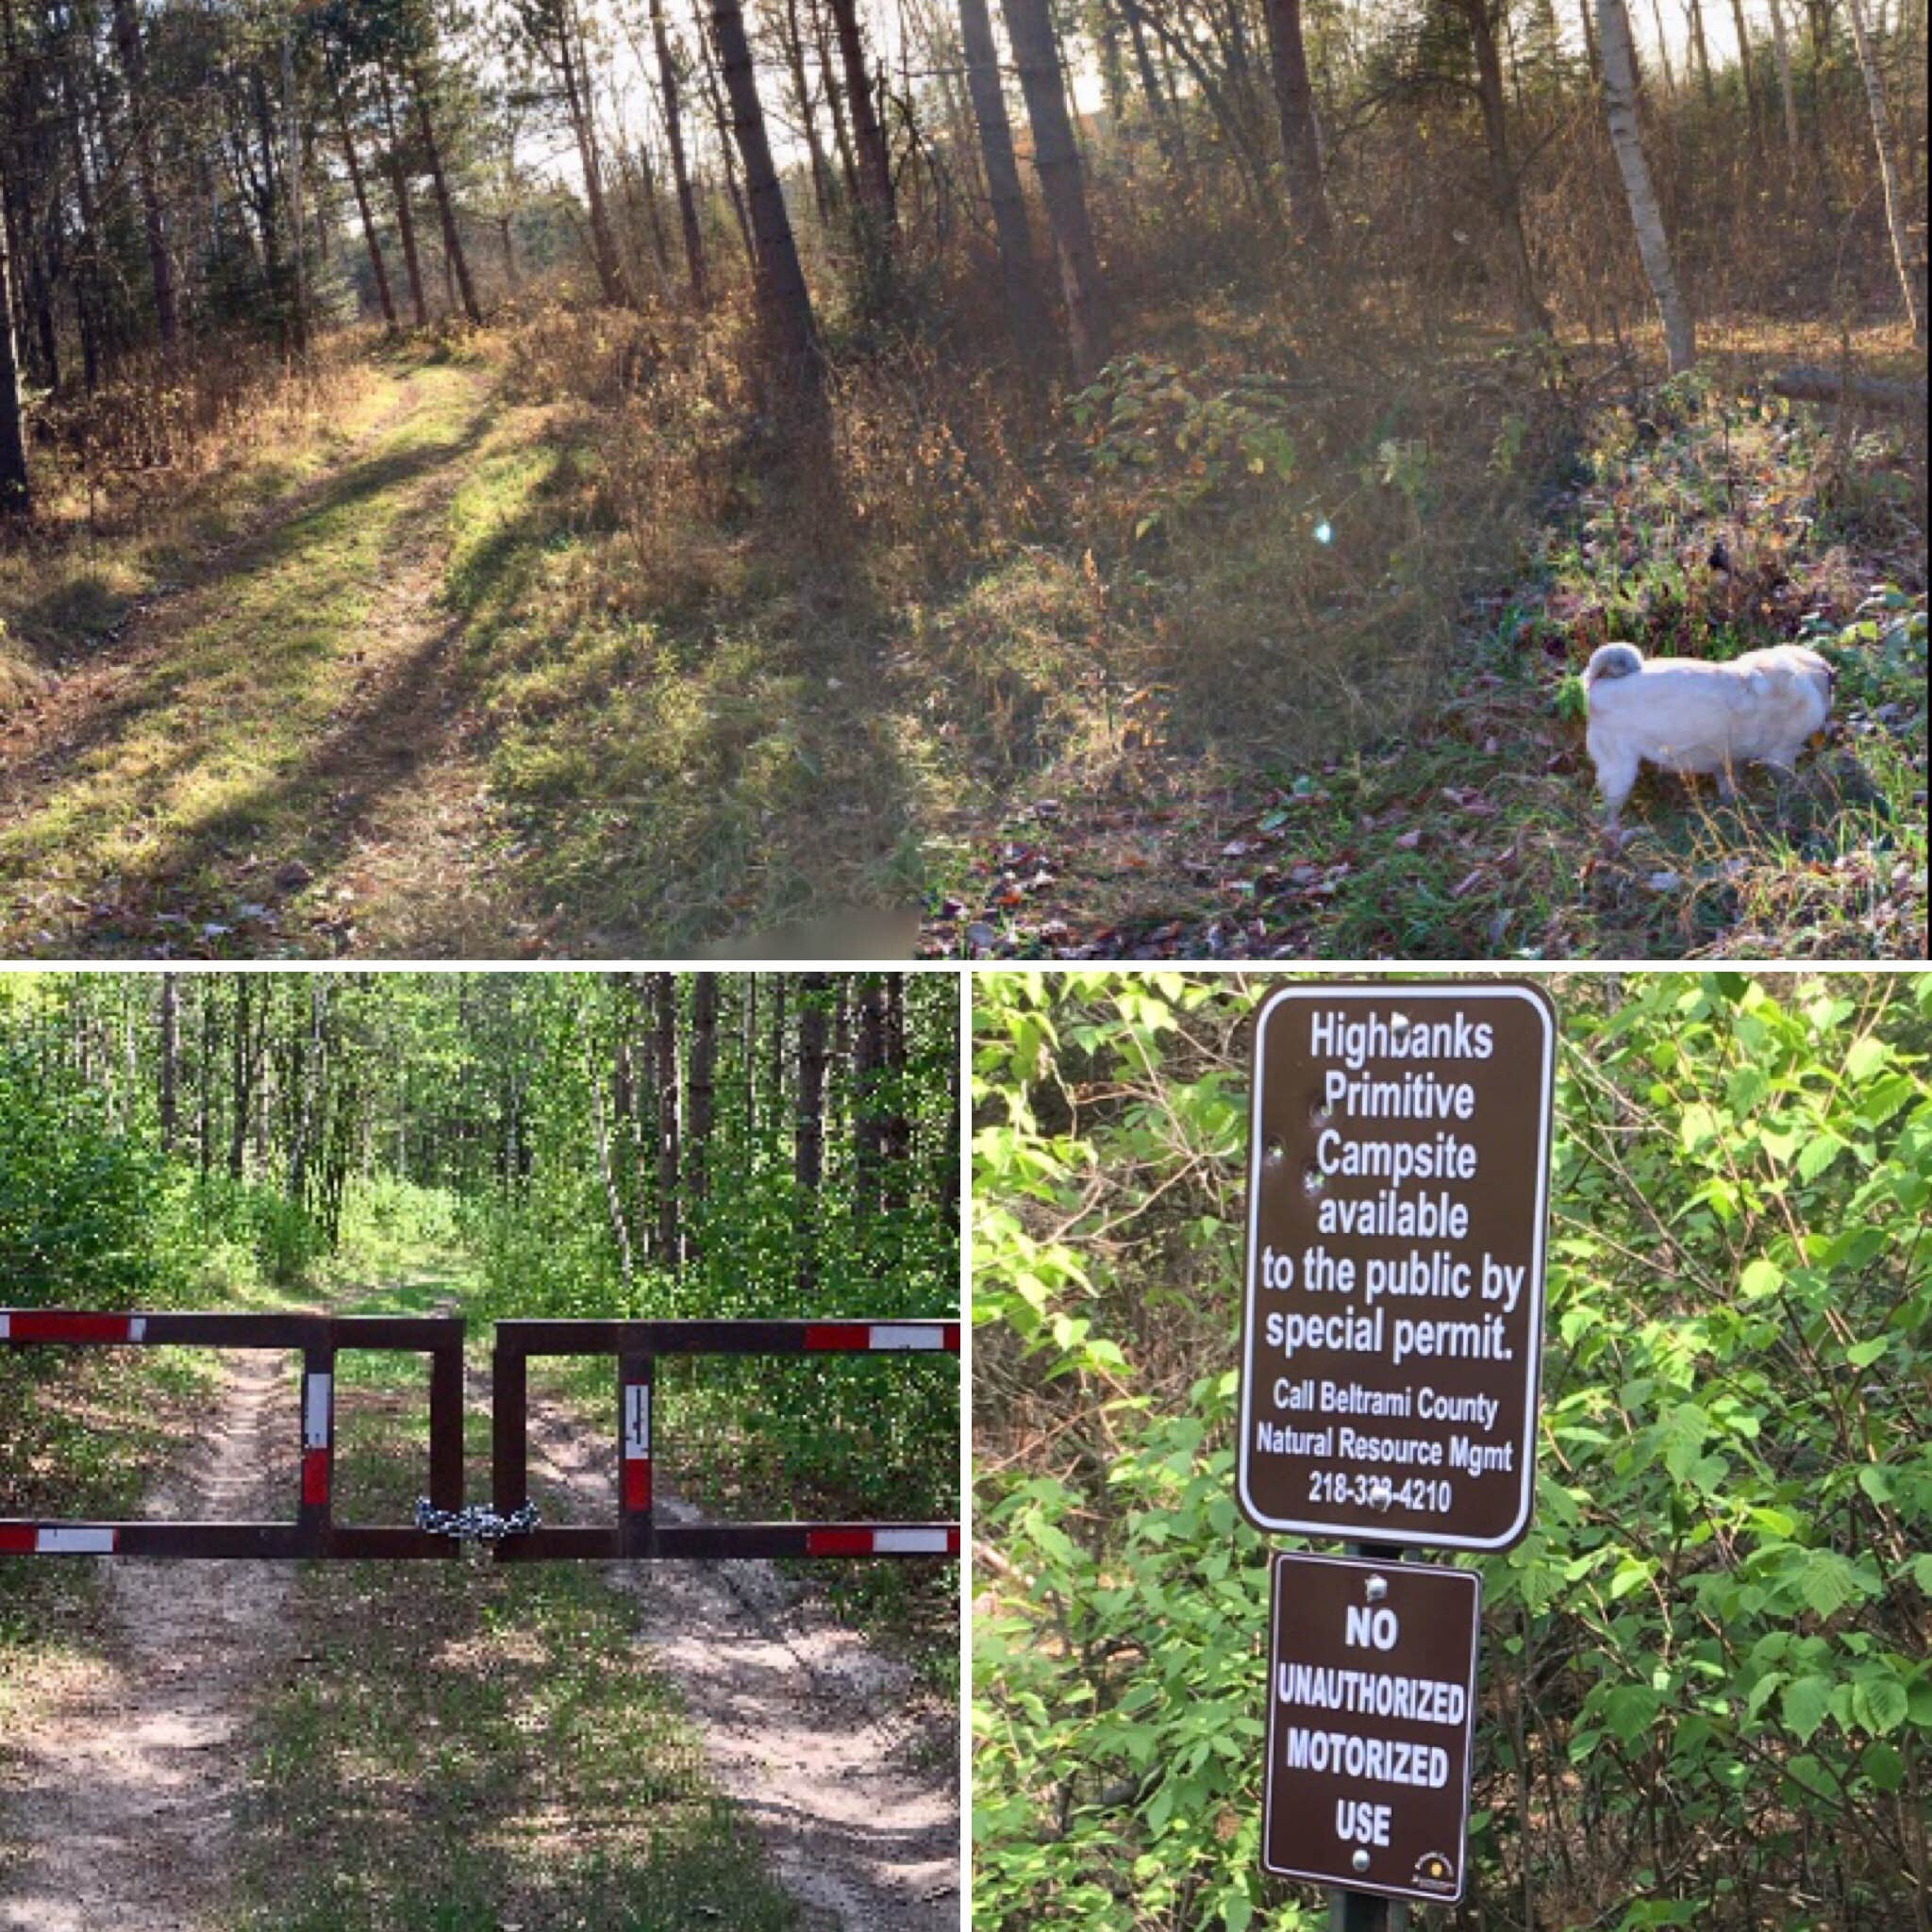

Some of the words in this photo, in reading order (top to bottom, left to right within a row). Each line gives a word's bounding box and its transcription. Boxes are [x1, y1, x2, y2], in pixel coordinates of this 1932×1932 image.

[1310, 1010, 1493, 1069] Highbanks
[1324, 1070, 1474, 1119] Primitive
[1317, 1128, 1477, 1188] Campsite
[1318, 1189, 1469, 1239] available
[1262, 1245, 1293, 1290] to
[1304, 1245, 1356, 1292] the
[1366, 1250, 1472, 1305] public
[1481, 1253, 1525, 1312] by
[1266, 1306, 1384, 1357] special
[1393, 1312, 1513, 1365] permit.
[1274, 1377, 1314, 1411] Call
[1321, 1380, 1411, 1417] Beltrami
[1418, 1387, 1498, 1431] County
[1257, 1422, 1333, 1457] Natural
[1339, 1427, 1442, 1466] Resource
[1449, 1436, 1512, 1476] Mgmt
[1345, 1606, 1398, 1650] NO
[1278, 1662, 1465, 1725] UNAUTHORIZED
[1287, 1727, 1449, 1789] MOTORIZED
[1336, 1799, 1391, 1846] USE
